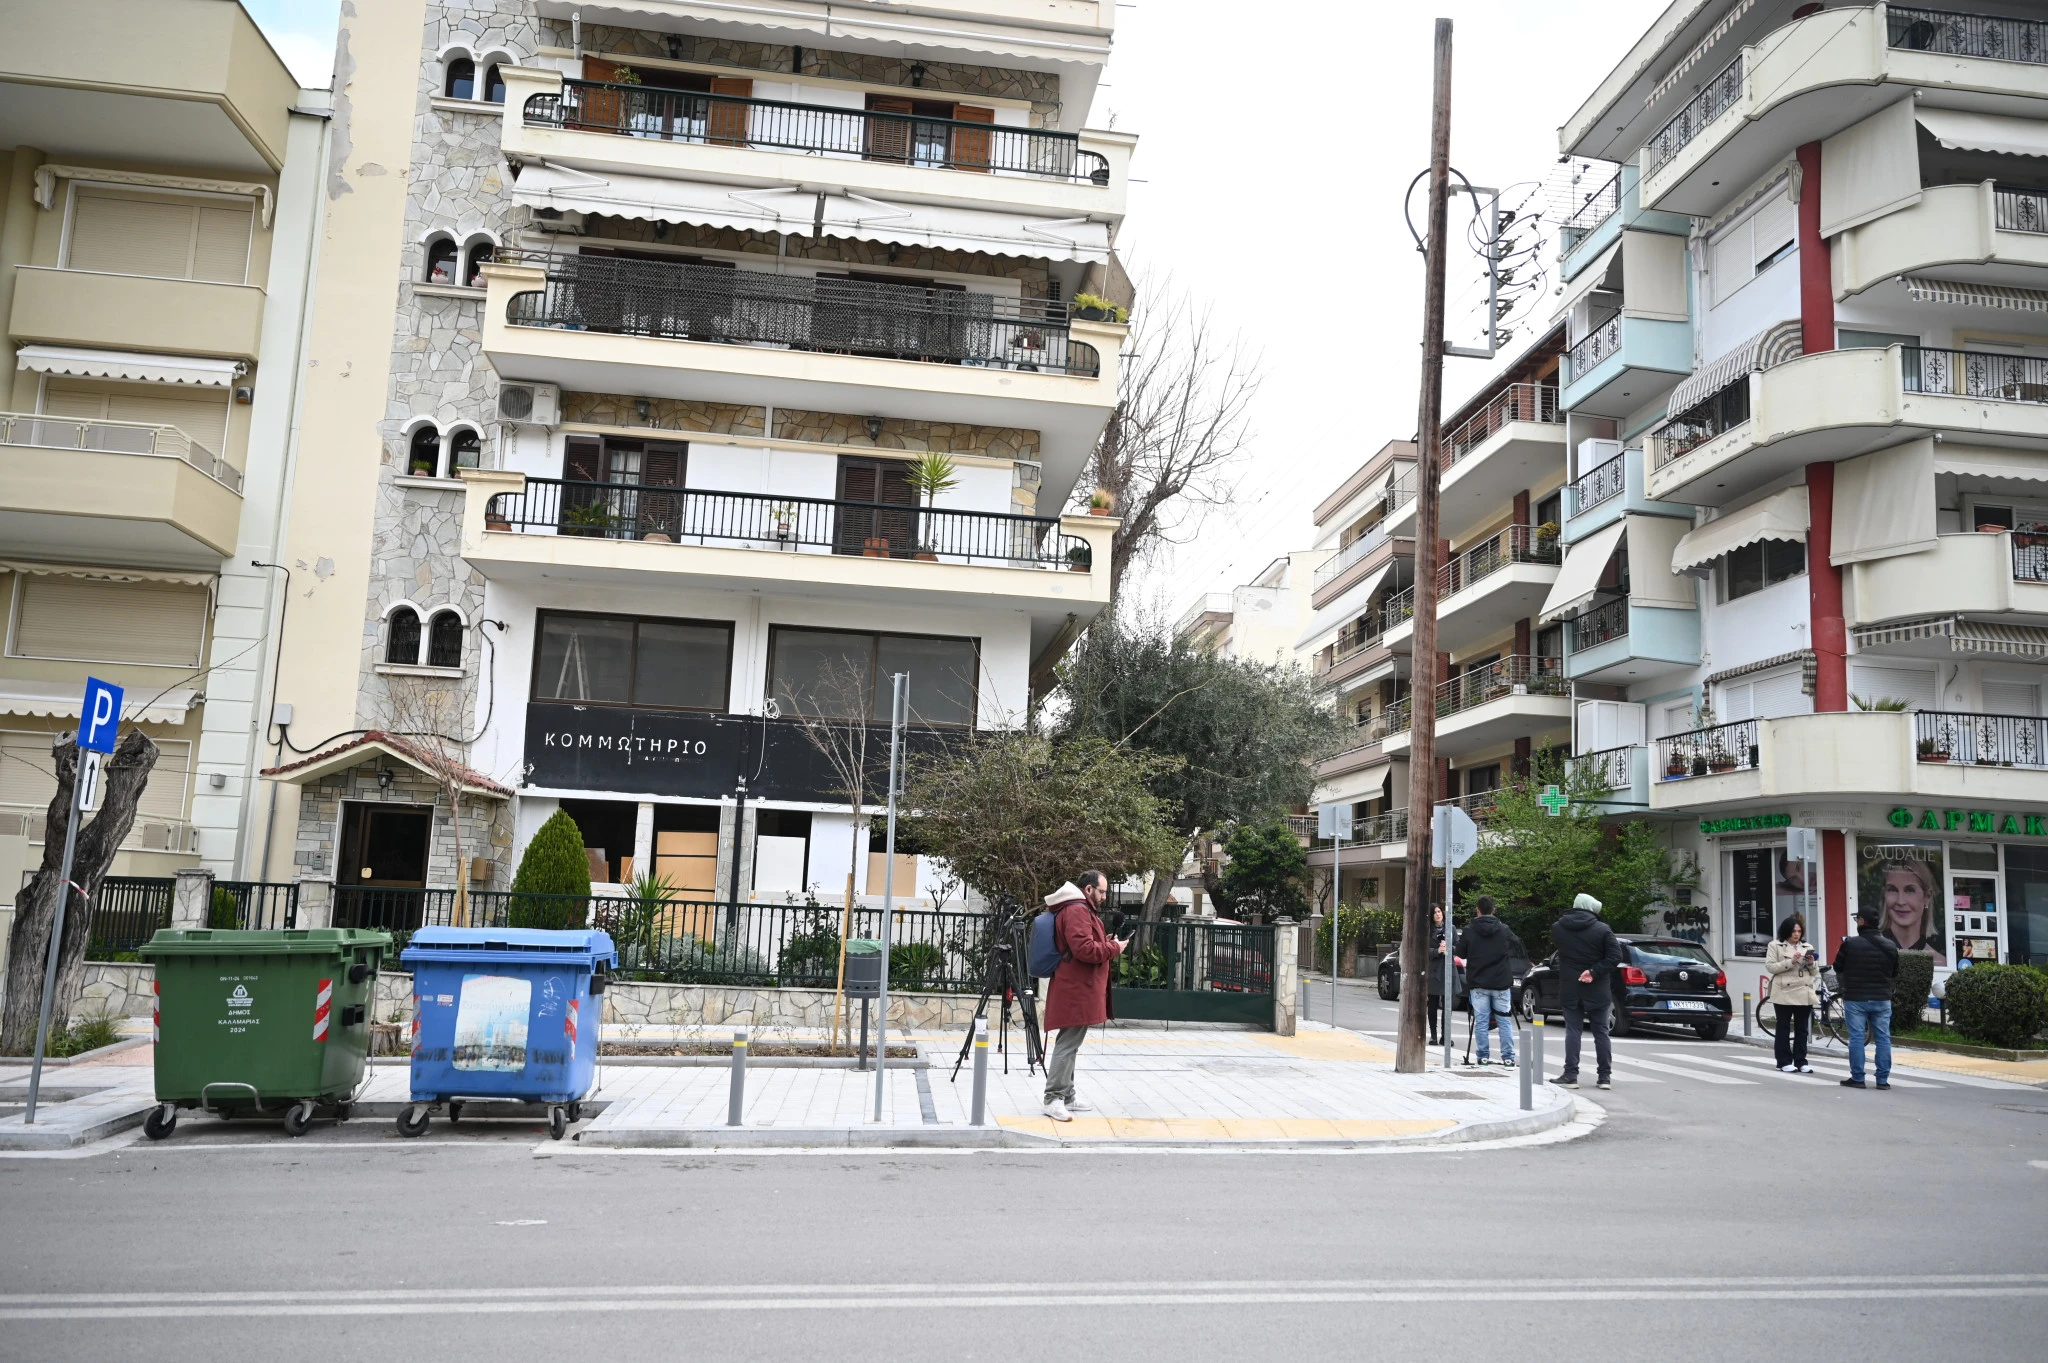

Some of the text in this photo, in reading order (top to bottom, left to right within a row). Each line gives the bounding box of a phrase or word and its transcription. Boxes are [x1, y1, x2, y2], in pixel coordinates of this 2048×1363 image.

[88, 687, 113, 744] P
[544, 732, 707, 755] ΚΟΜΜΩΤΗΡΙΟ
[1887, 807, 2047, 835] ΦΑΡΜΑΚ
[1862, 845, 1936, 863] CAUDALIE
